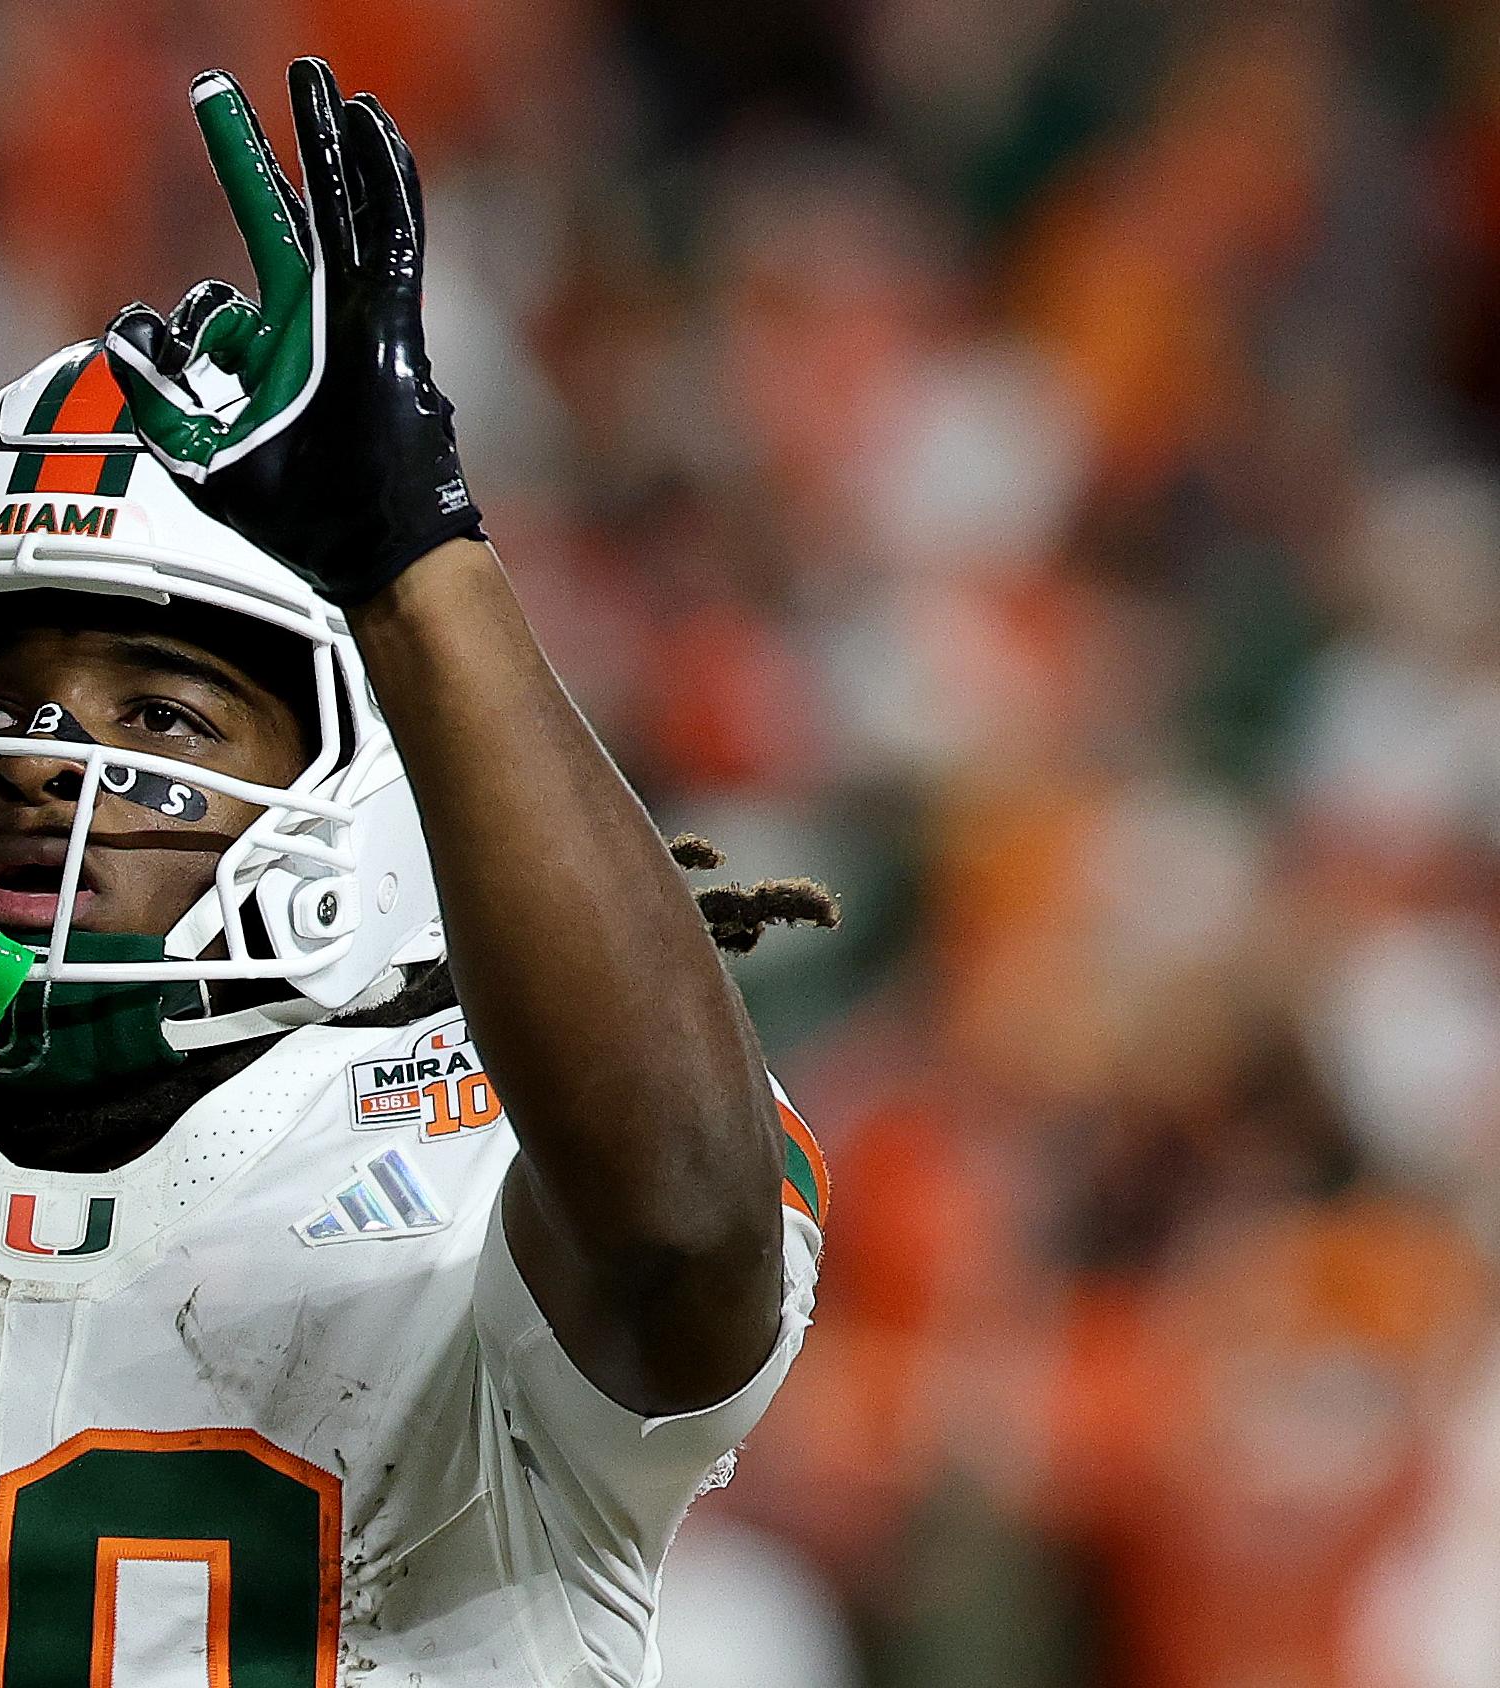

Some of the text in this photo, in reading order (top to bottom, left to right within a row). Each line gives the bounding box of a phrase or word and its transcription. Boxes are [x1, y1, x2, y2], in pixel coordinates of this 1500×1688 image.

[373, 1051, 472, 1088] MIRA
[369, 1093, 412, 1112] 1961
[422, 1071, 503, 1137] 10
[4, 1193, 117, 1256] U
